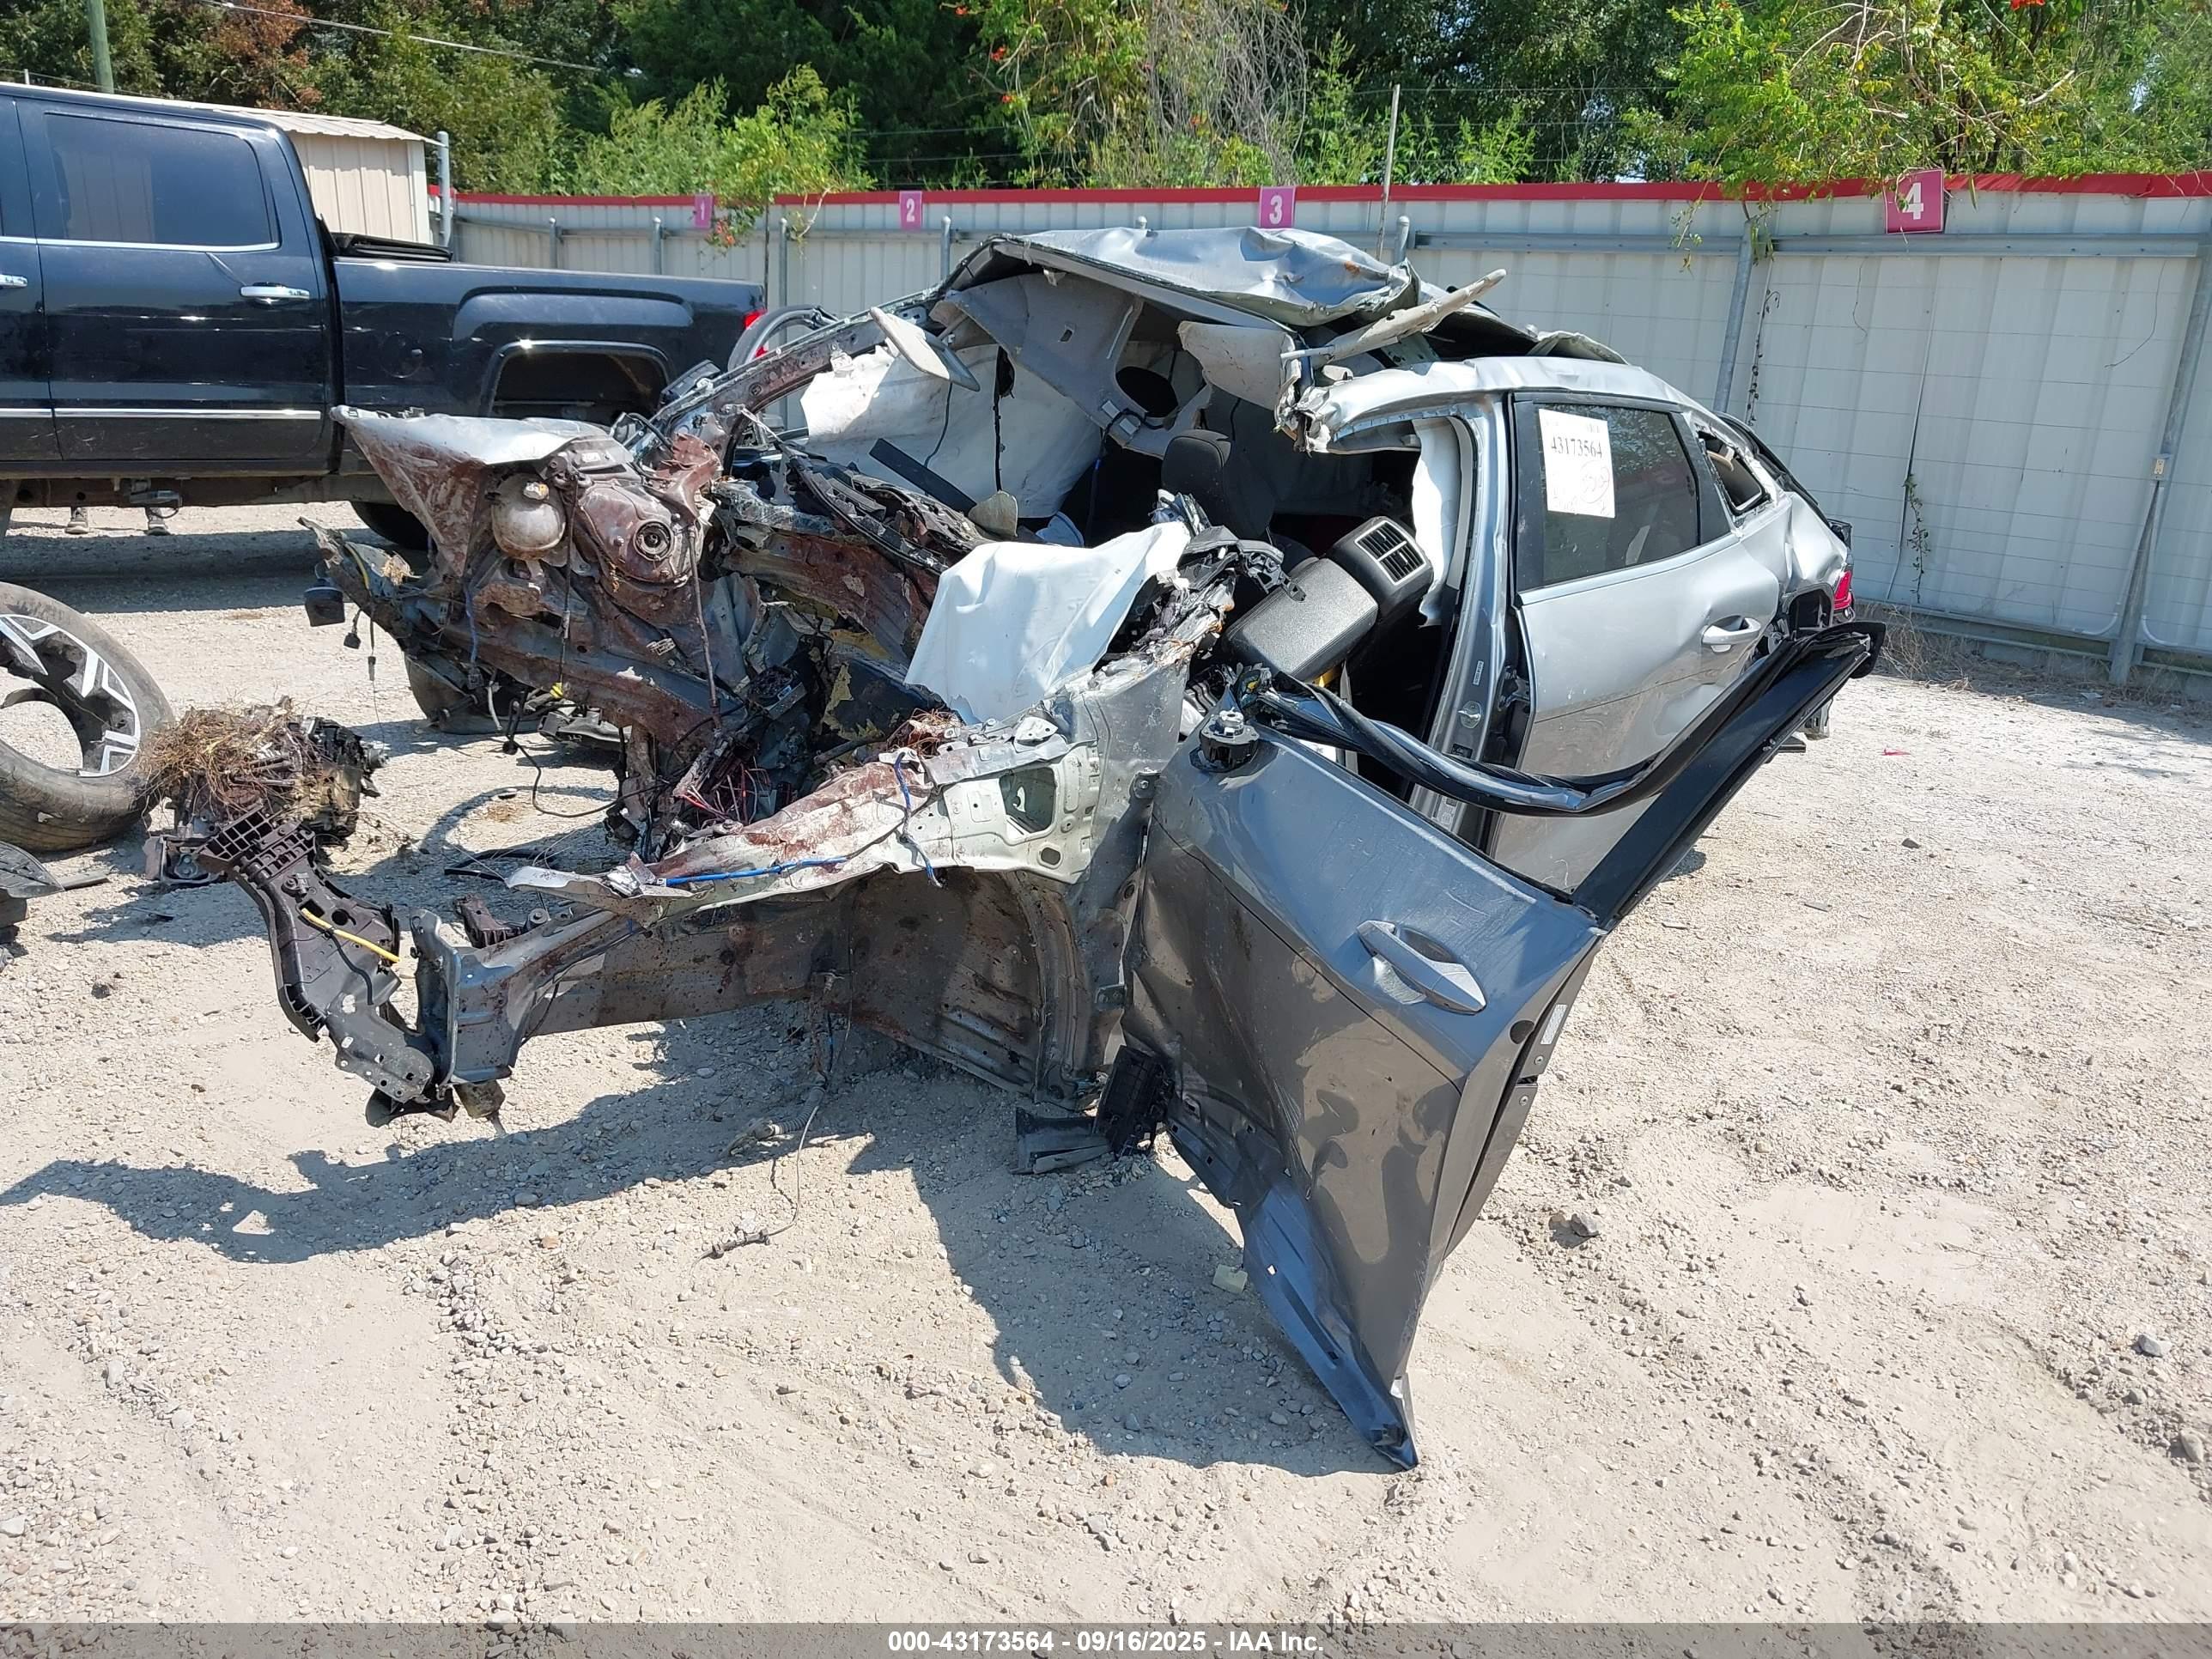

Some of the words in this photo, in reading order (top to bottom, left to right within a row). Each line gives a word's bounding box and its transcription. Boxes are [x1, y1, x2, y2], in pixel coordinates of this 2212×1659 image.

[906, 198, 915, 222] 2
[1269, 195, 1283, 225] 3
[1901, 182, 1924, 220] 4
[1551, 435, 1603, 459] 43173564
